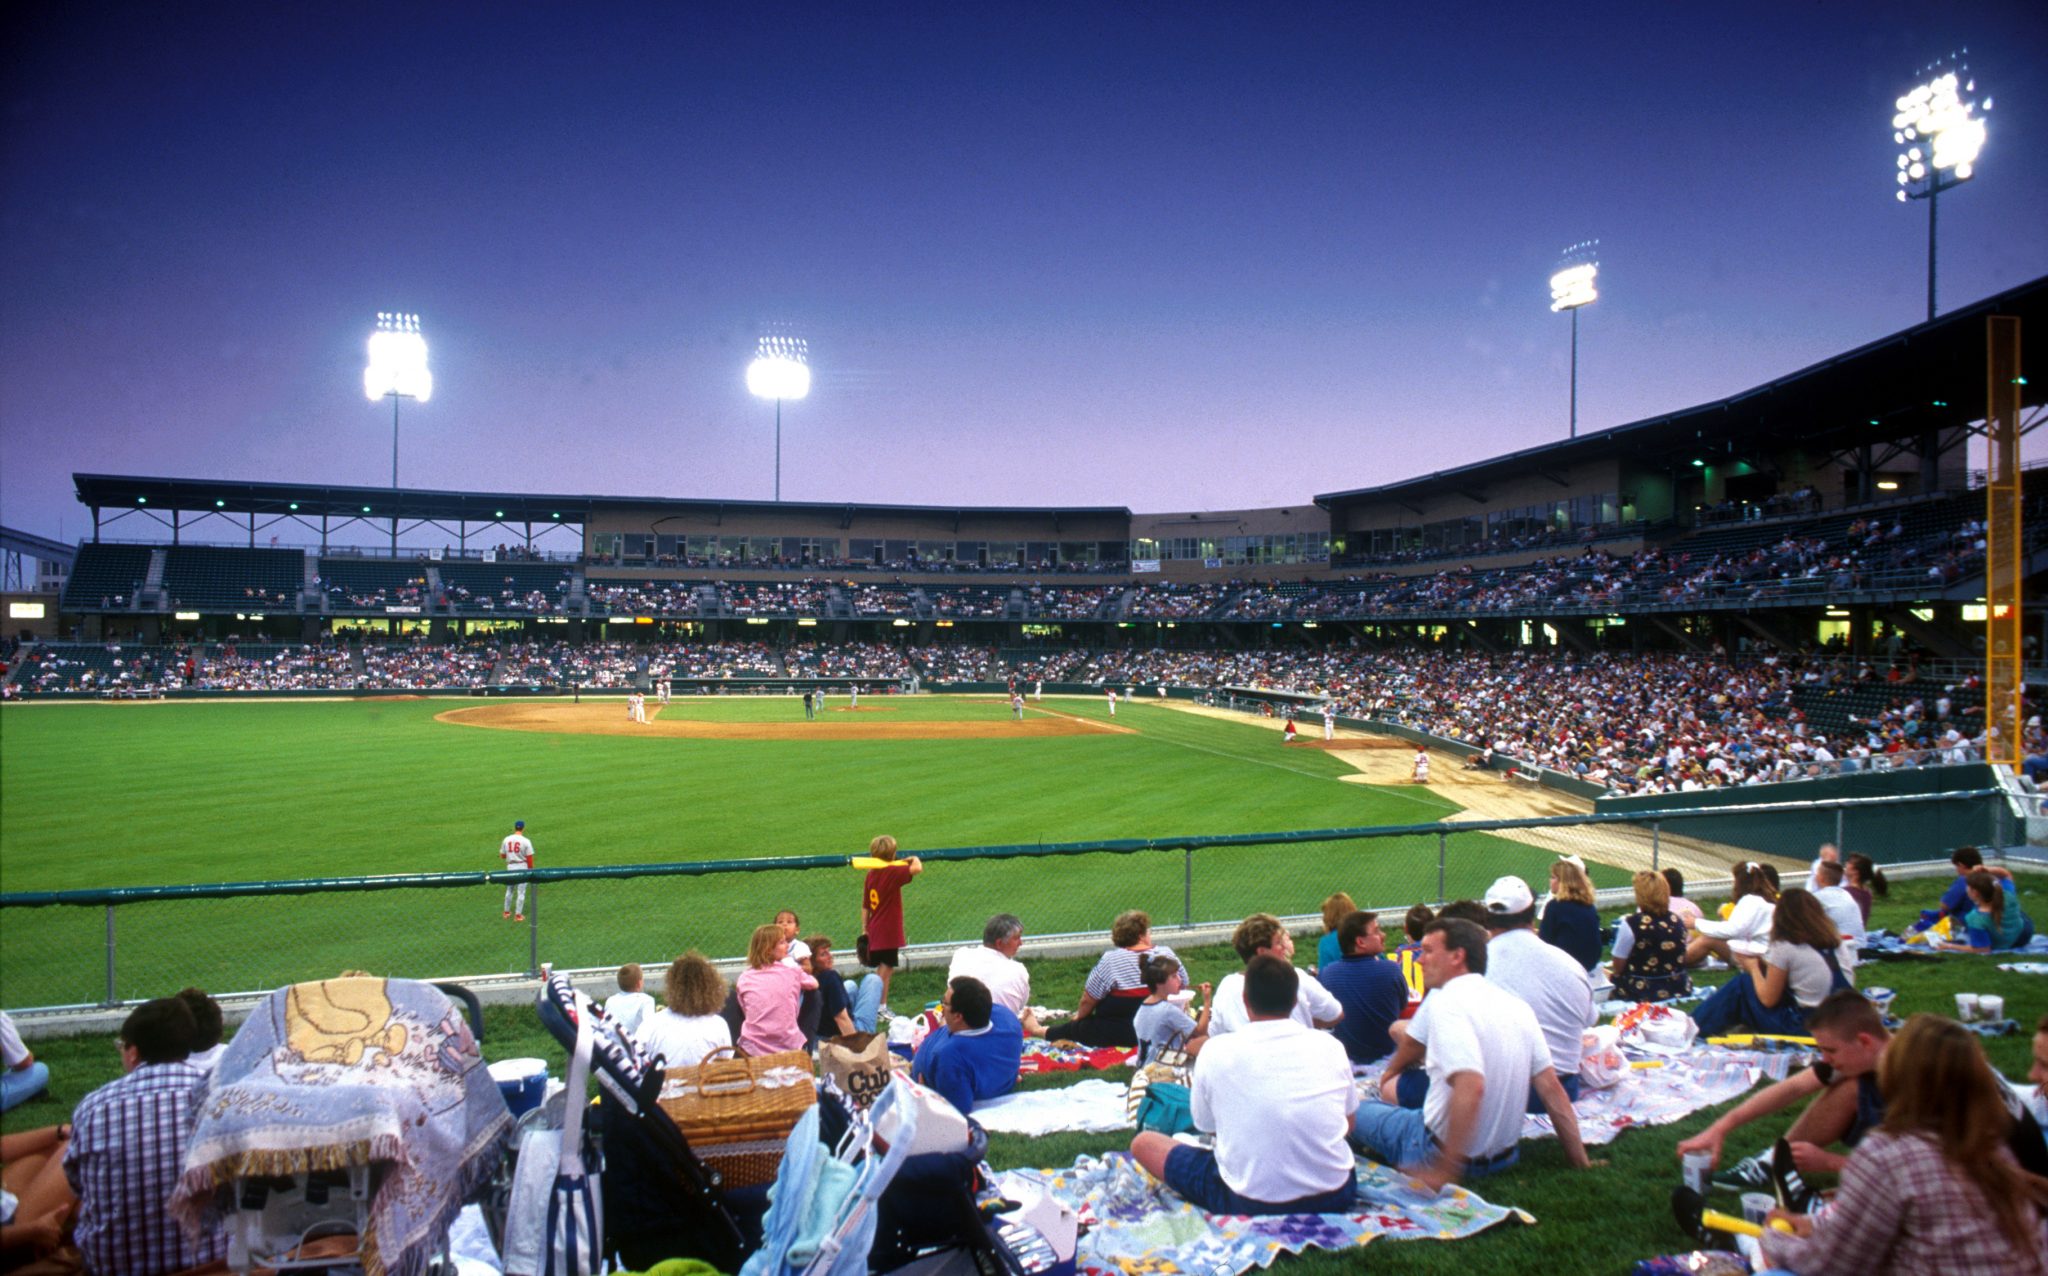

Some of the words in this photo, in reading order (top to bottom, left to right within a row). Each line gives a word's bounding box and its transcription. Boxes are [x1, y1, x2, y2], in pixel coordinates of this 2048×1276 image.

[507, 842, 521, 853] 16
[869, 888, 880, 910] 9
[848, 1066, 890, 1094] Cub
